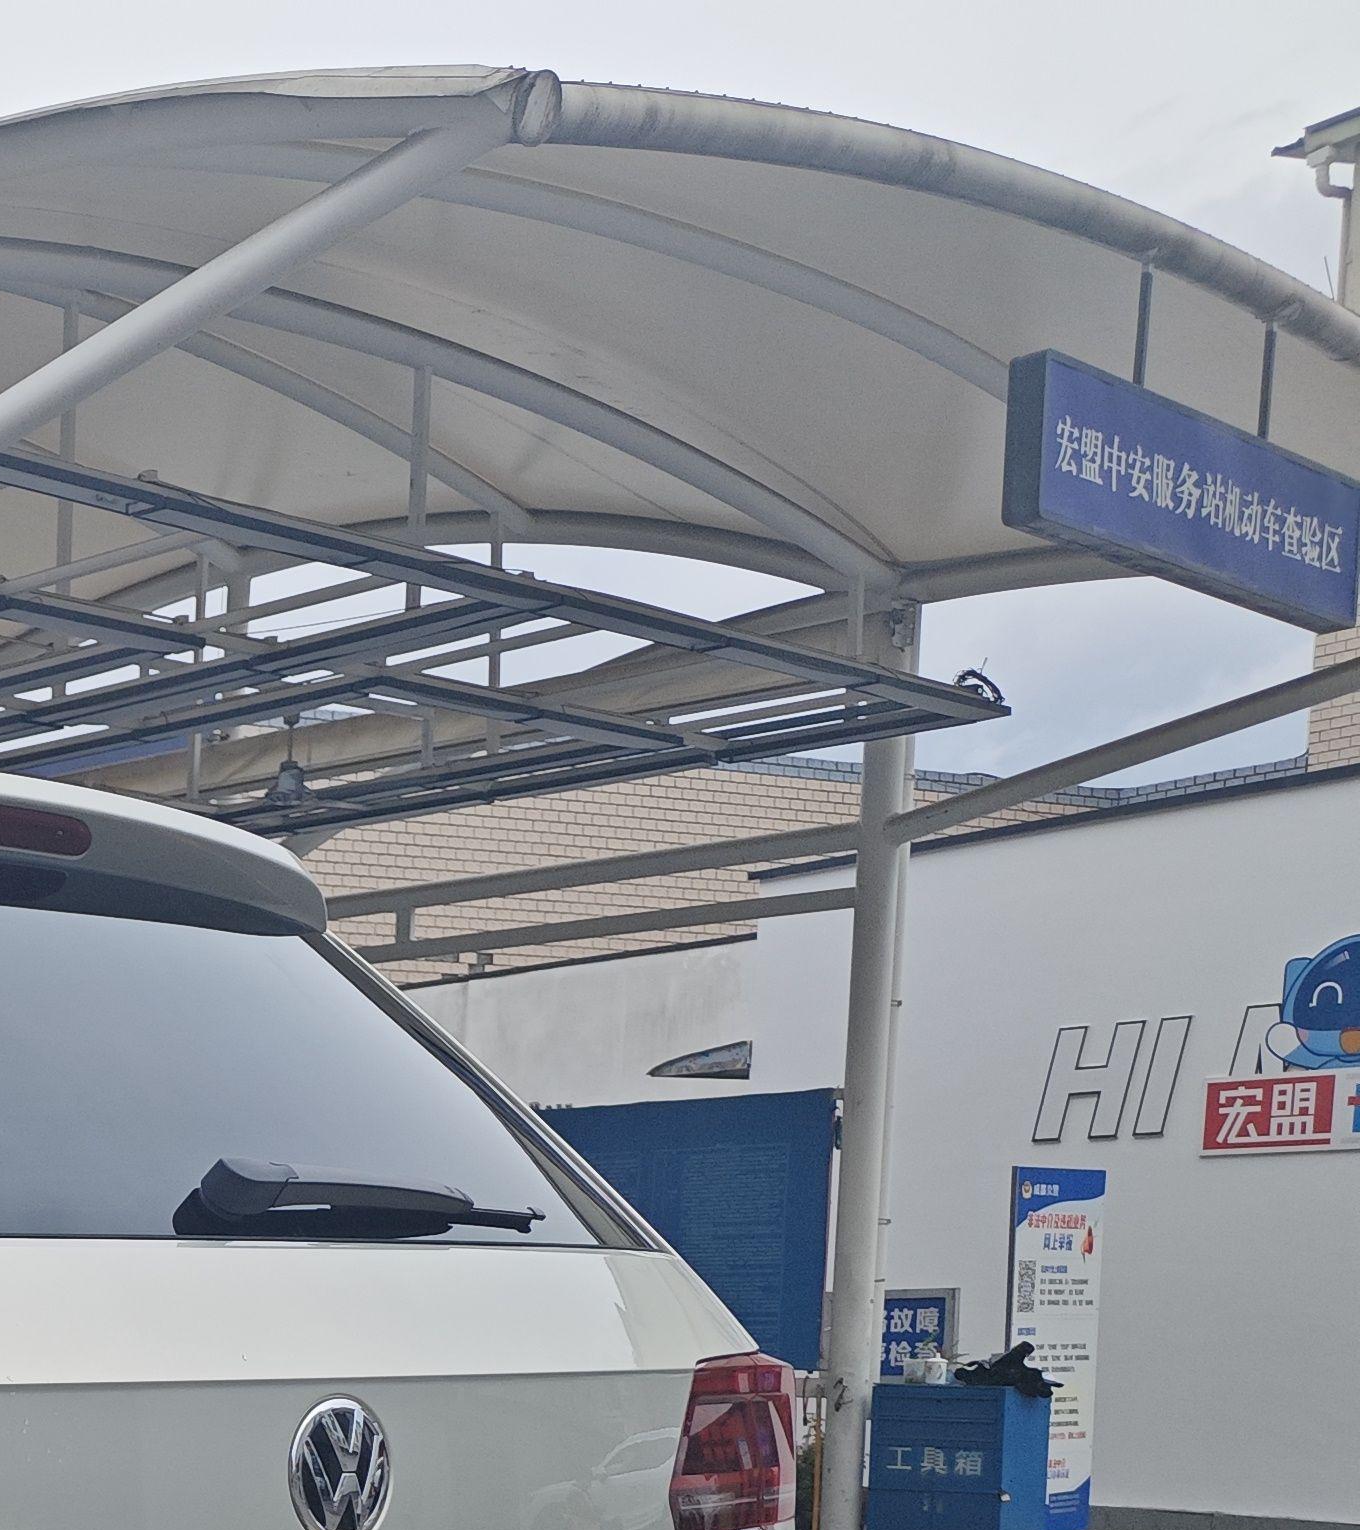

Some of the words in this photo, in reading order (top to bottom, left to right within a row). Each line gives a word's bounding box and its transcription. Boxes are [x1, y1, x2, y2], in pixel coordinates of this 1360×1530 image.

[1055, 415, 1343, 573] 宏盟中安服务站机动车查验区
[1216, 1082, 1331, 1143] 宏盟
[886, 1446, 983, 1476] 工具箱
